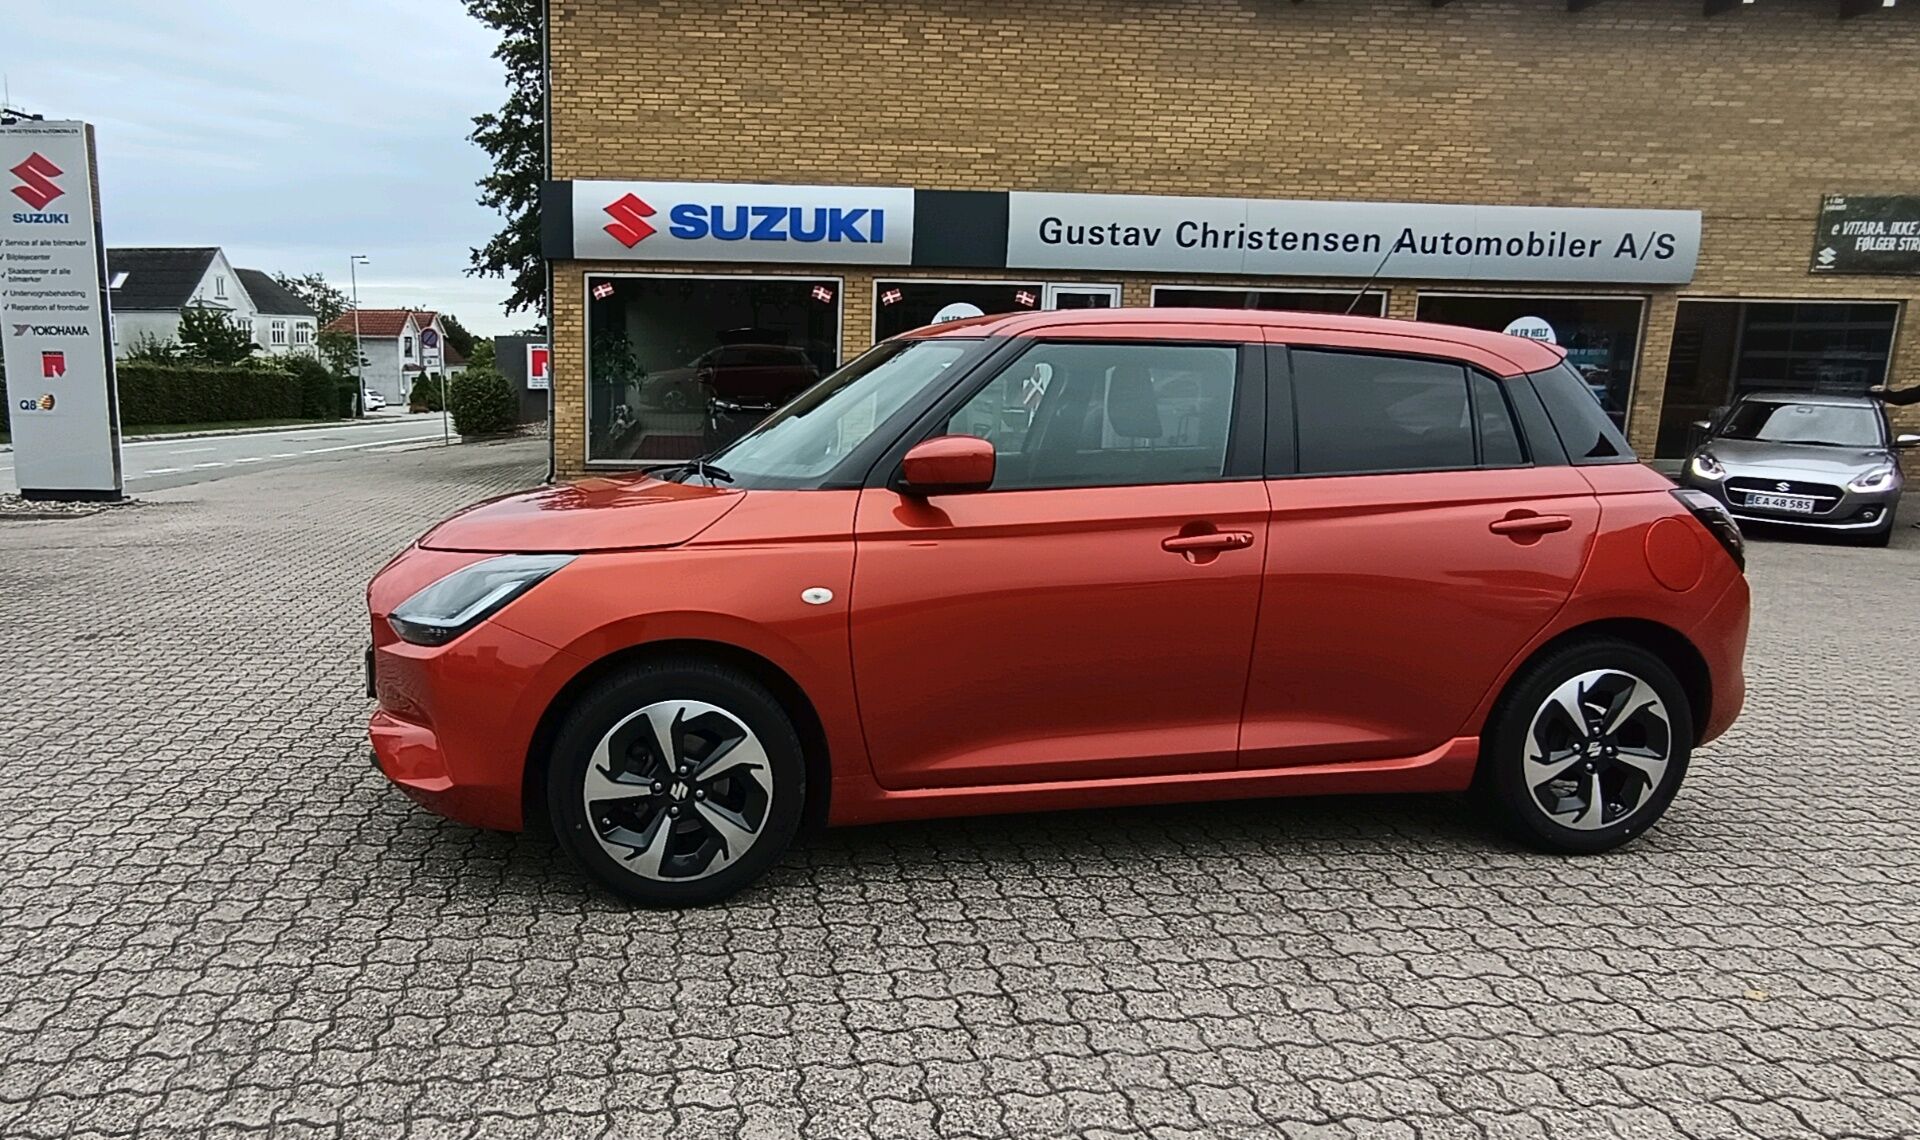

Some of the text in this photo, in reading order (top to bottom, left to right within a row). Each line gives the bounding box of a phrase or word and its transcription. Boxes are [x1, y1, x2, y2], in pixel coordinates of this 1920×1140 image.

[12, 213, 69, 224] SUZUKI
[669, 204, 884, 243] SUZUKI
[1831, 224, 1840, 235] e
[1842, 221, 1887, 235] VITARA.
[1889, 221, 1919, 235] IKKE
[1039, 217, 1676, 260] Gustav Christensen Automobiler A/S
[1855, 236, 1920, 251] FØLGER STR
[6, 253, 50, 261] Bilplejecenter
[8, 267, 49, 275] Skadecenter
[10, 290, 86, 298] Undervognsbehandling
[31, 325, 90, 336] YOKOHAMA
[1520, 328, 1529, 337] ER
[1531, 328, 1548, 337] HELT
[20, 400, 37, 410] Q8
[1755, 496, 1811, 510] EA 48 585
